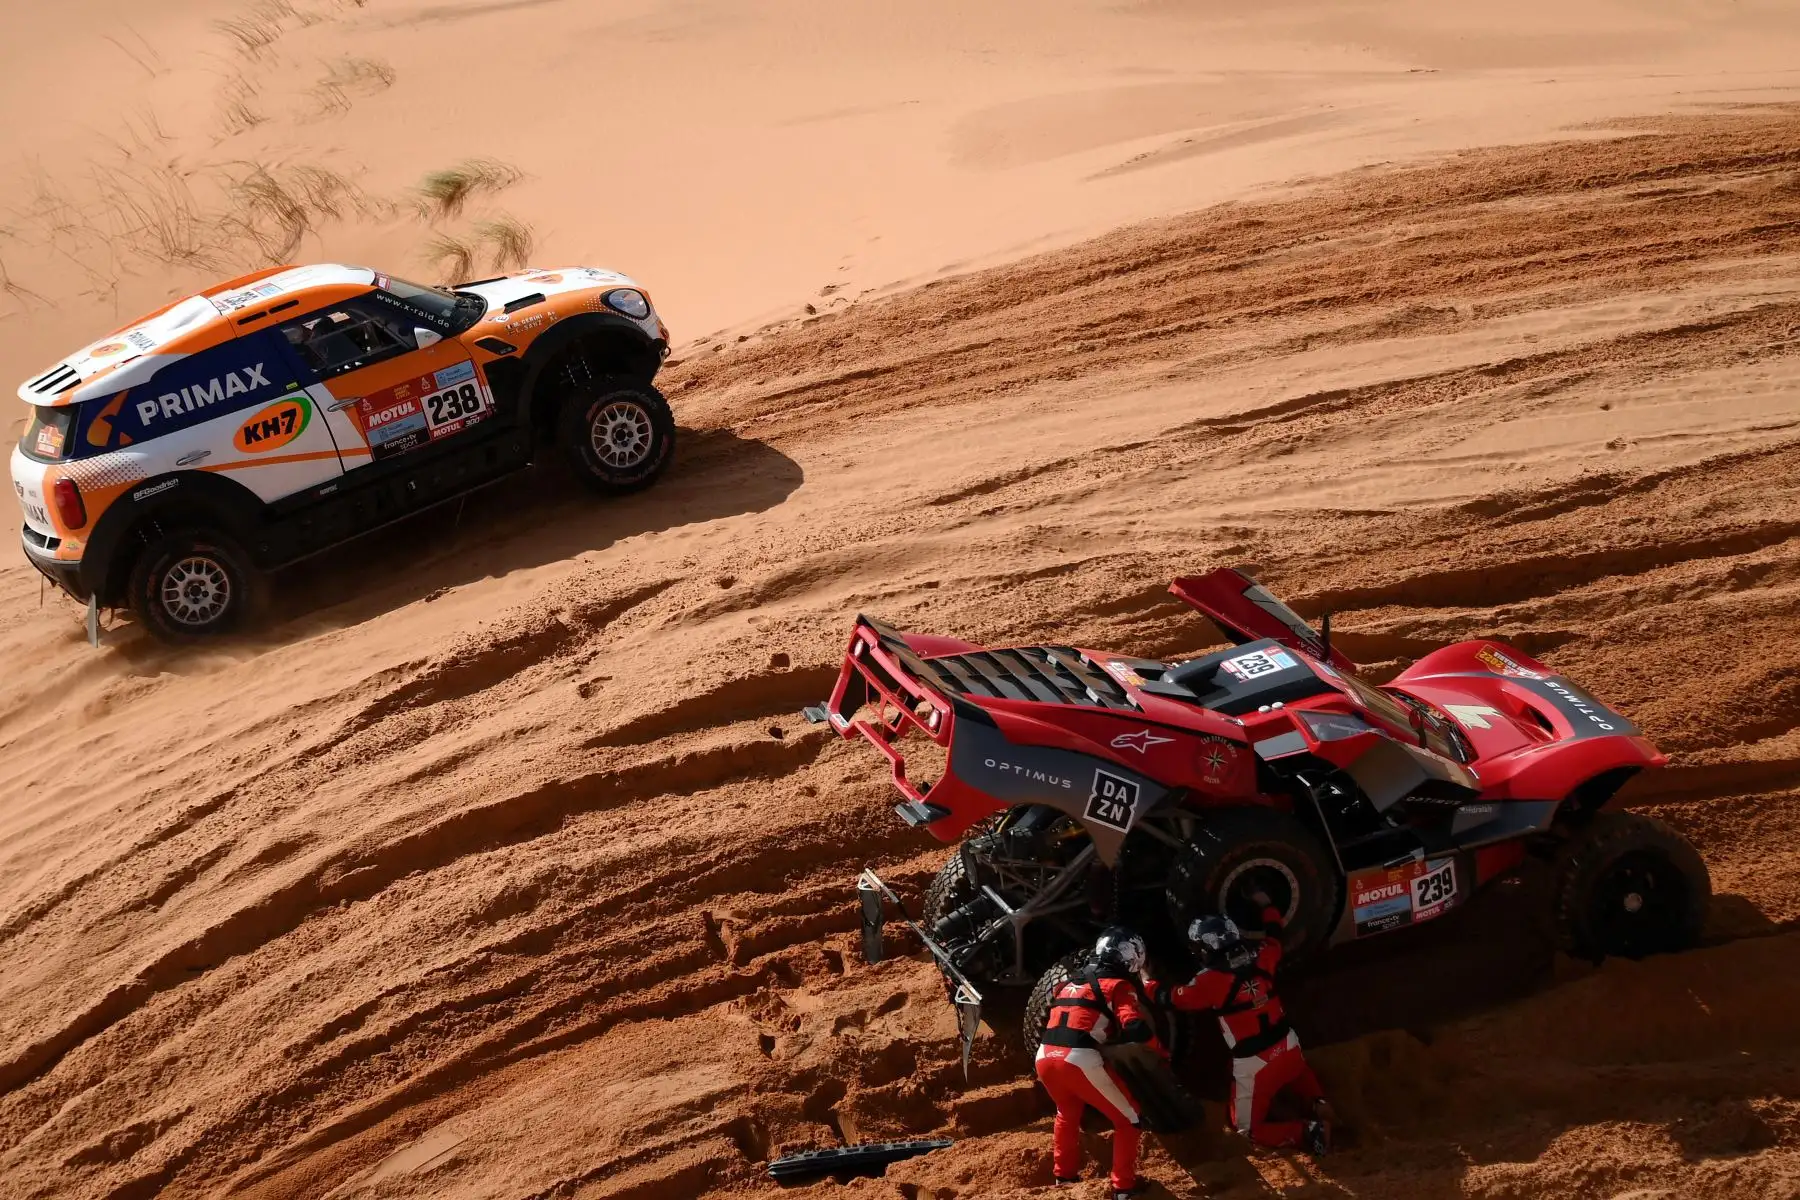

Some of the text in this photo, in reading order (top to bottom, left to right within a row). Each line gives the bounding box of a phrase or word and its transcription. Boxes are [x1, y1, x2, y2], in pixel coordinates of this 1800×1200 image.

[135, 362, 272, 427] PRIMAX
[427, 383, 480, 426] 238
[369, 401, 416, 428] MOTUL
[433, 422, 461, 438] MOTUL
[133, 478, 179, 501] BFGoodrich
[1236, 654, 1275, 675] 239
[1479, 650, 1505, 668] 2022
[1544, 681, 1614, 731] OPTIMUS
[984, 758, 1073, 789] OPTIMUS
[1358, 883, 1404, 905] MOTUL
[1417, 866, 1453, 907] 239
[1416, 906, 1440, 920] MOTUL
